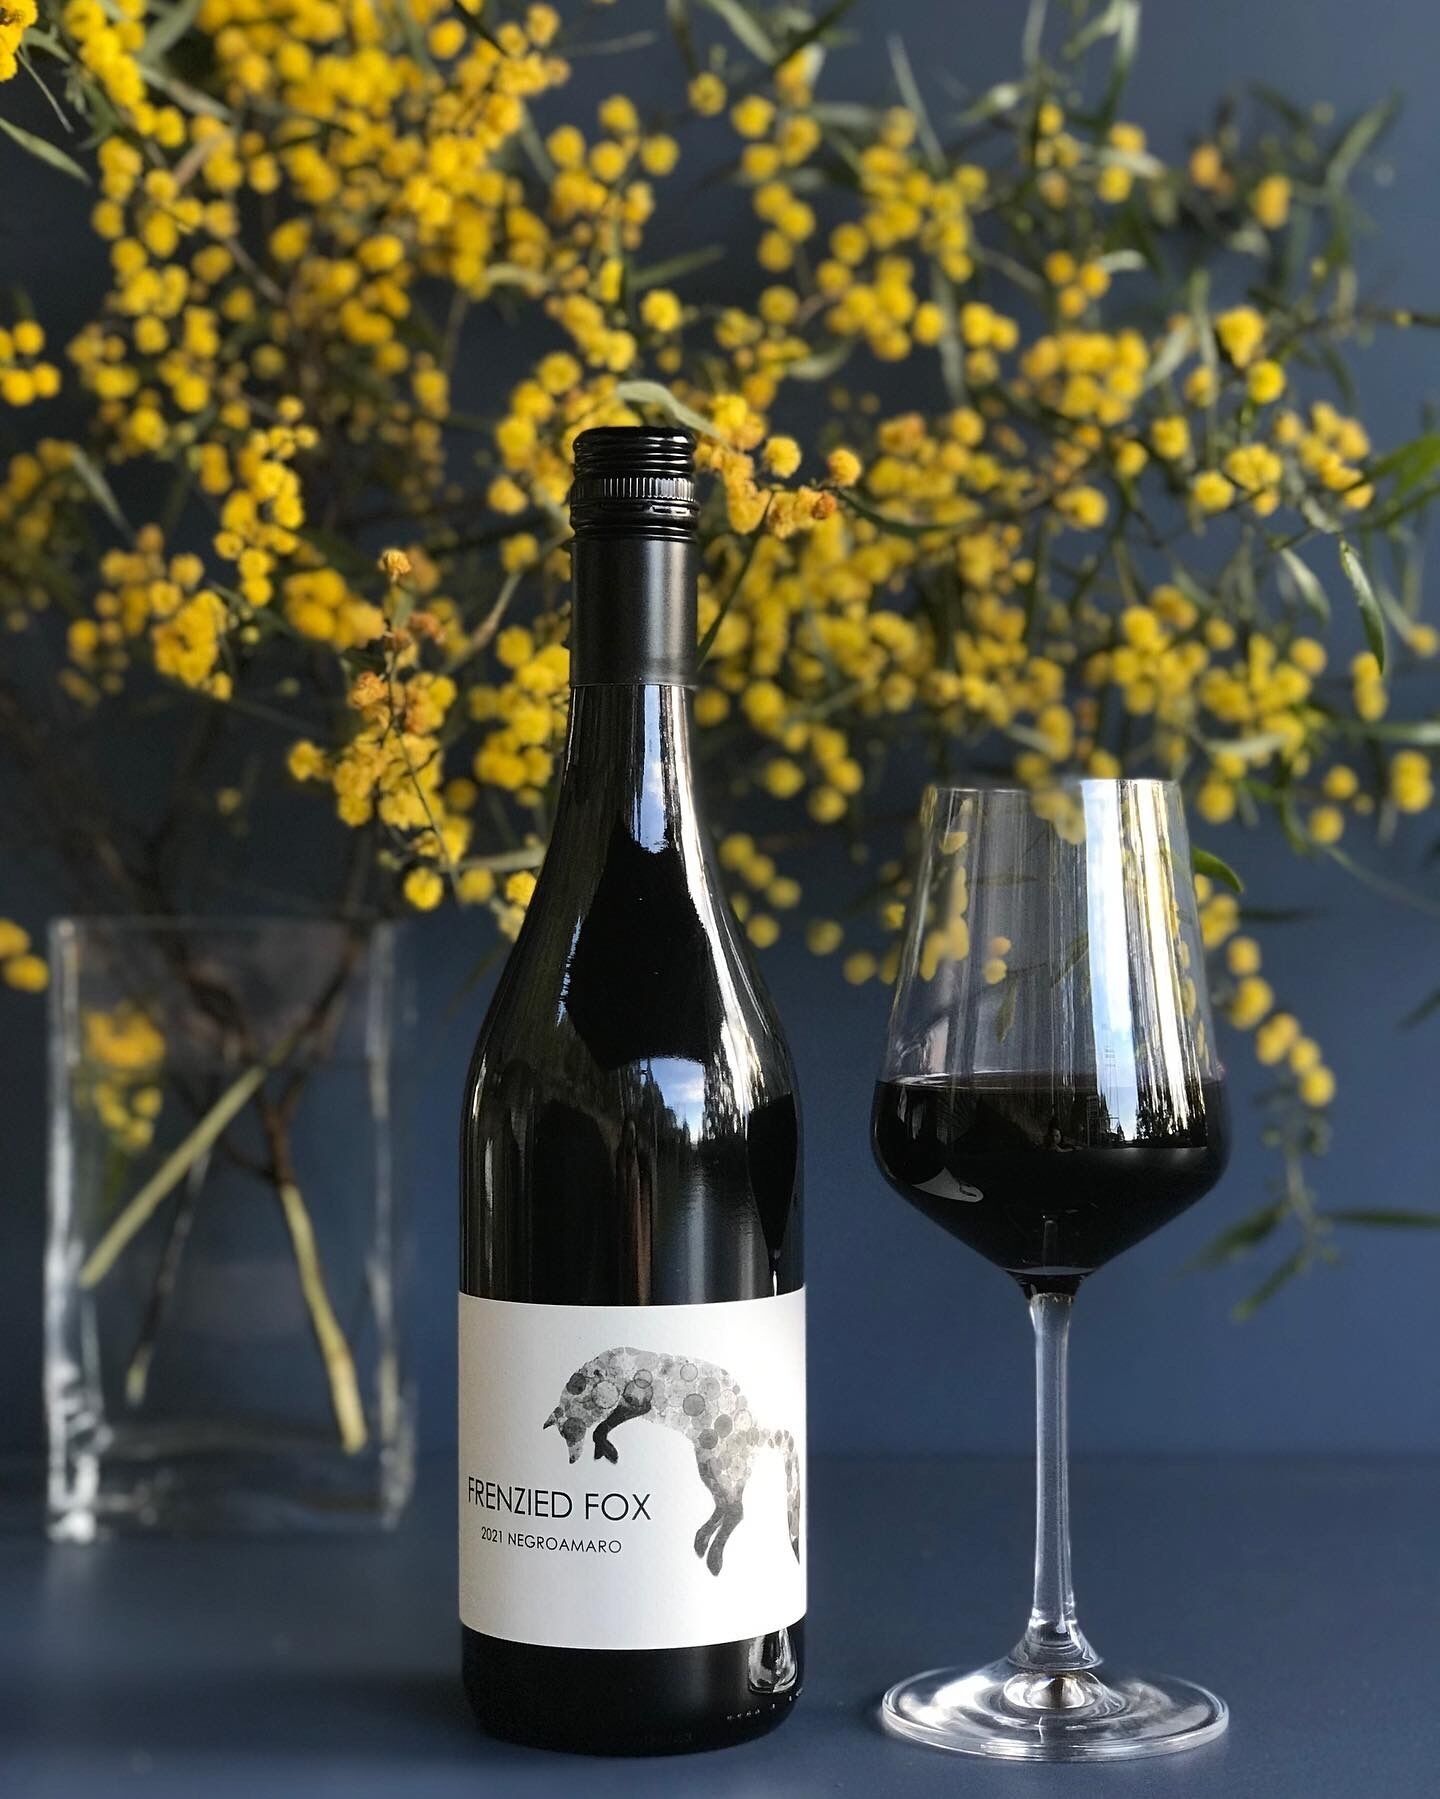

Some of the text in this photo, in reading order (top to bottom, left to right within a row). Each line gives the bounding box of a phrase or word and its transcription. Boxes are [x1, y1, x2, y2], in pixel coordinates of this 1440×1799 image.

[468, 1476, 652, 1521] FRENZIED FOX
[481, 1526, 622, 1554] 2021 NEGROAMARO
